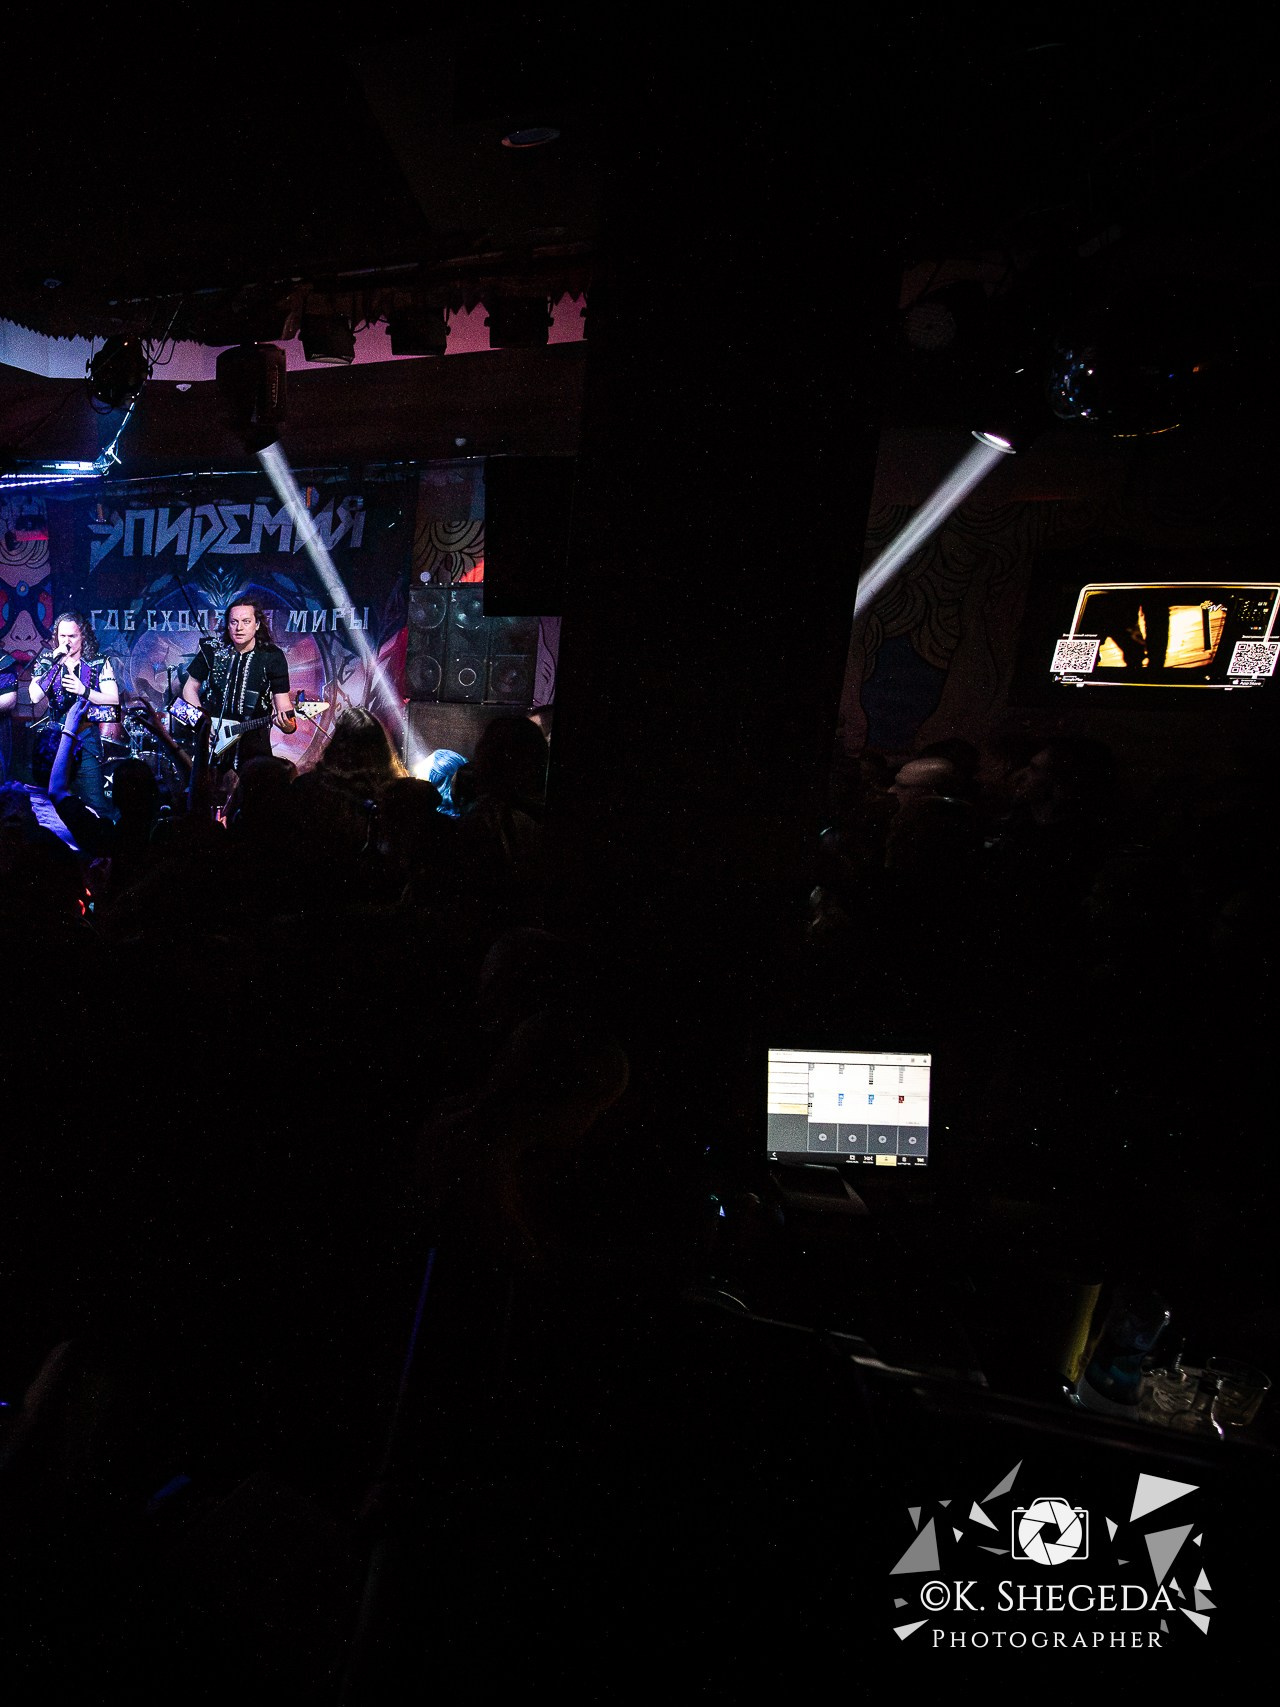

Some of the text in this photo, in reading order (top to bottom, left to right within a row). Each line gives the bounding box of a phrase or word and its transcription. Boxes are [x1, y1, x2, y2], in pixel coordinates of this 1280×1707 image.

[88, 501, 366, 573] ЭПИДЕМИЯ
[90, 607, 370, 633] ГДЕ СХОДЯЯ МИРЫ
